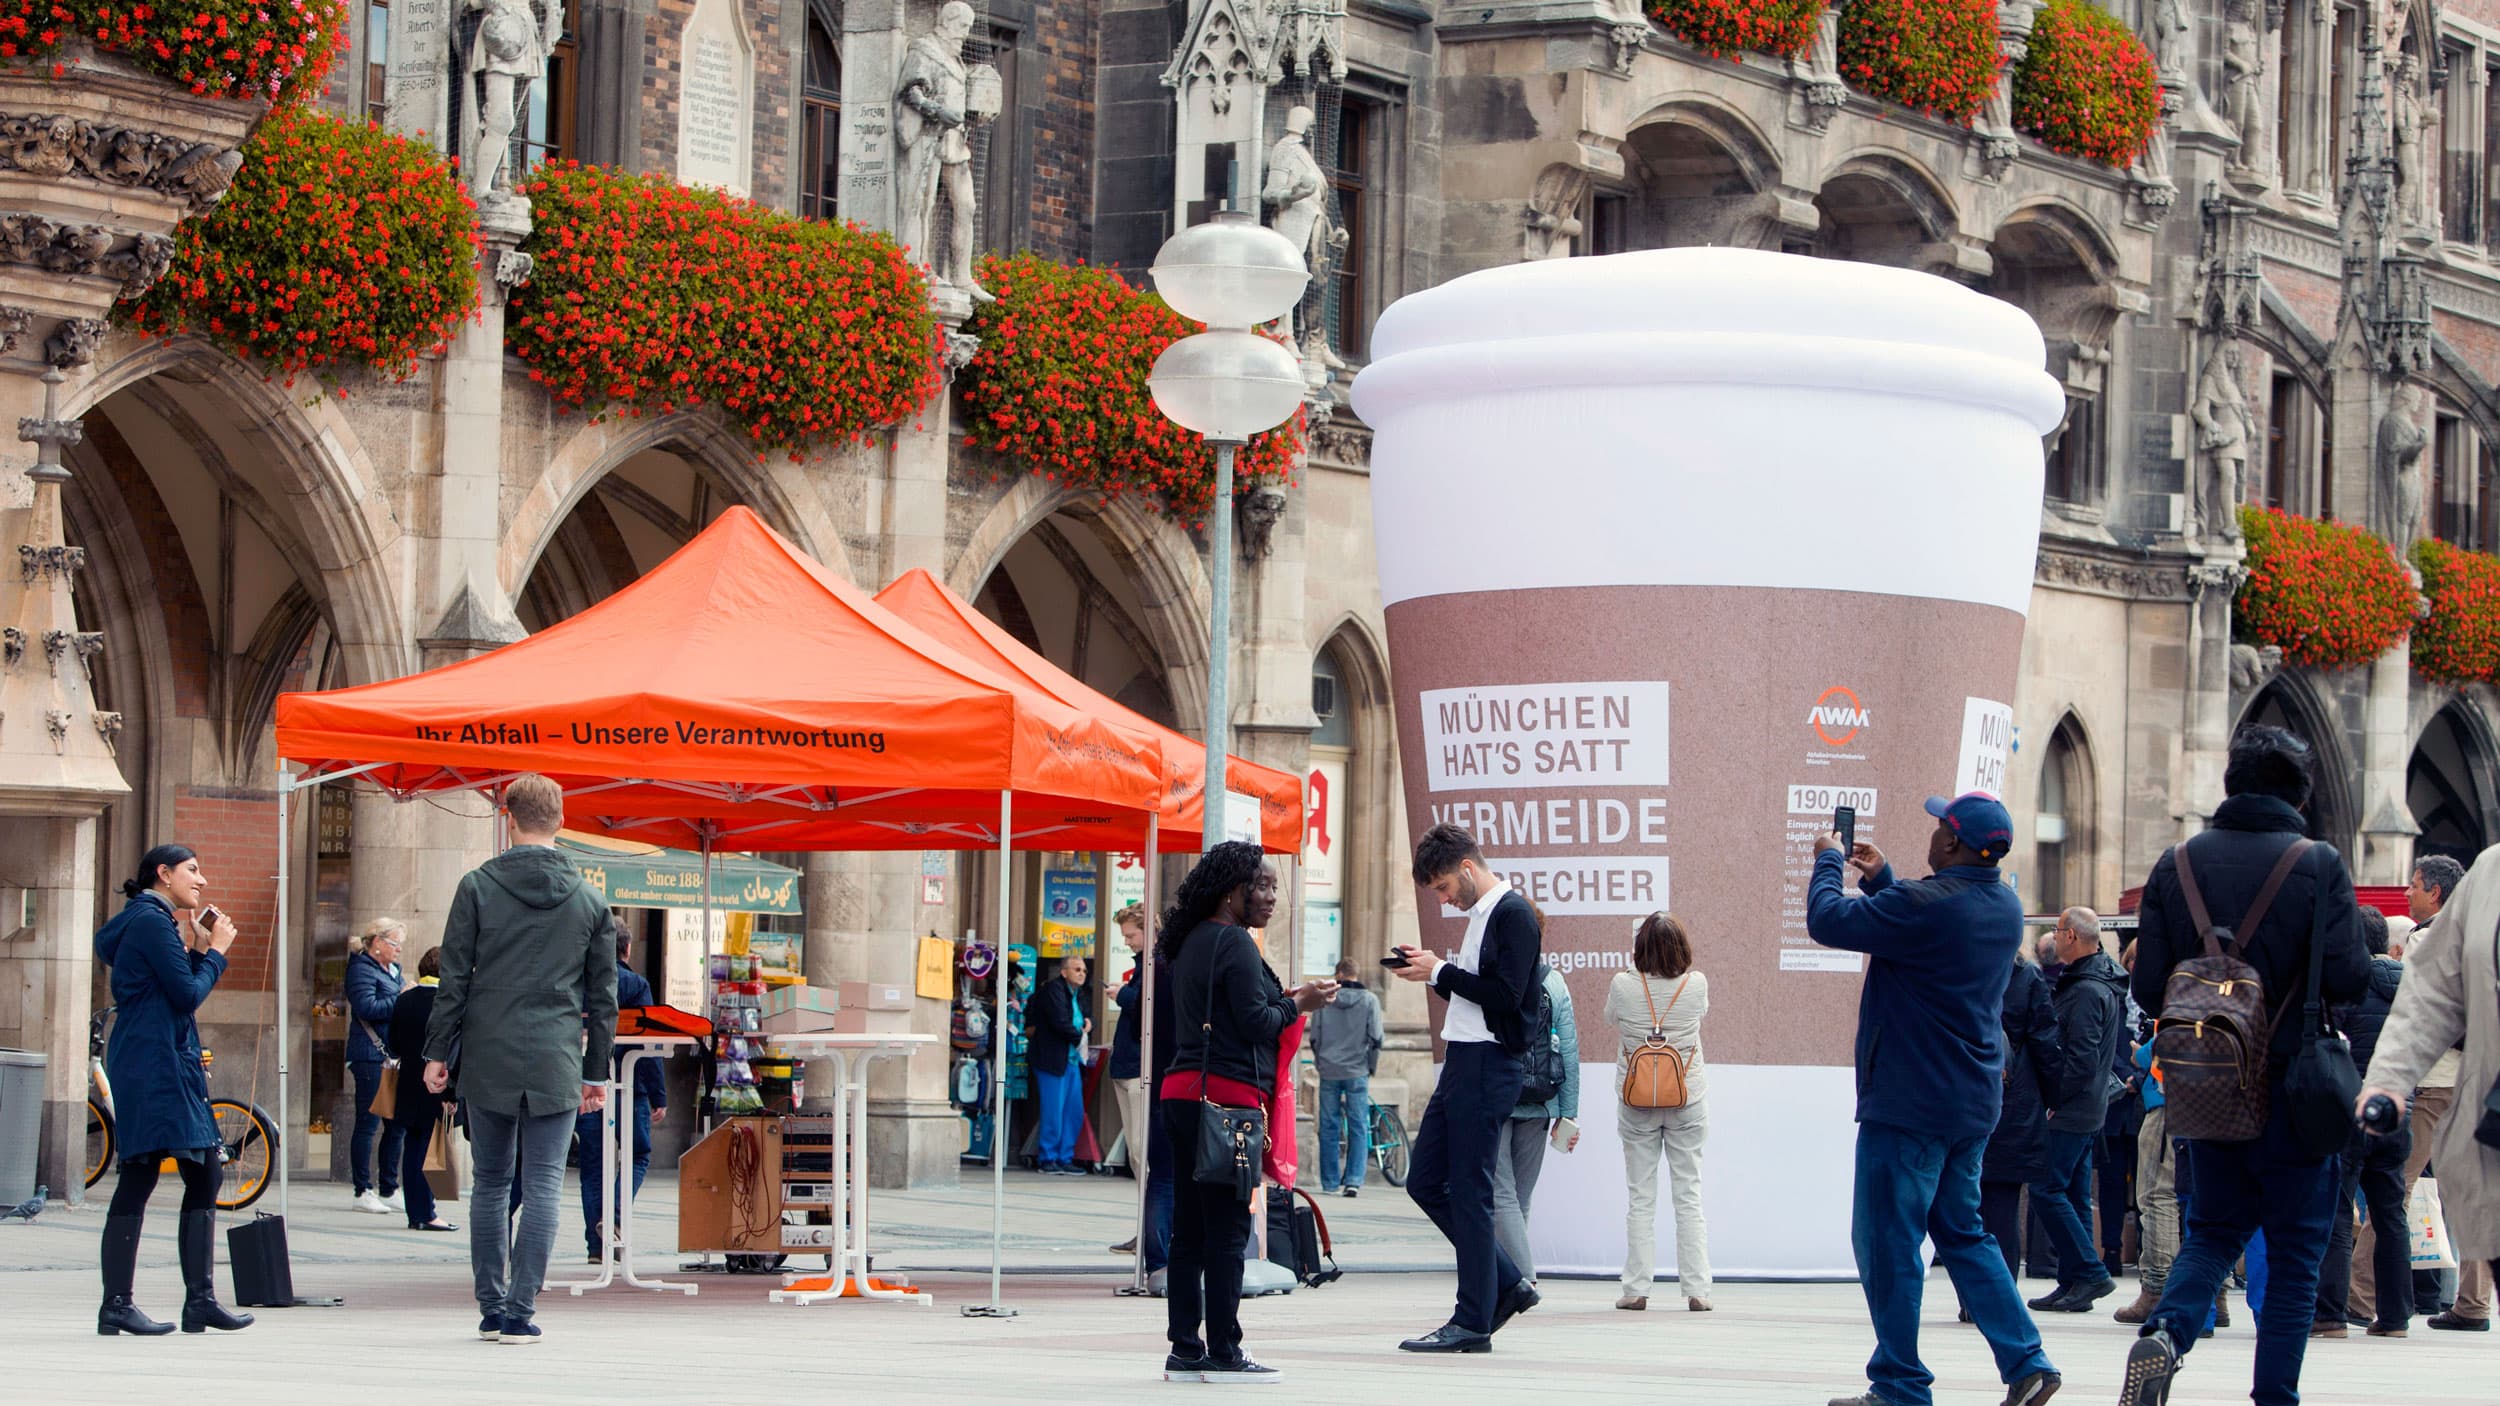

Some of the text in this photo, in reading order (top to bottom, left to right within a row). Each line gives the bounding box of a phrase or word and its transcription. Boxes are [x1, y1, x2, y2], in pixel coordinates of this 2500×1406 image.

[1439, 693, 1630, 735] MÜNCHEN
[1807, 706, 1870, 727] AWM
[416, 726, 452, 741] Ihr
[460, 722, 540, 744] Abfall
[571, 722, 669, 745] Unsere
[675, 720, 886, 753] Verantwortung
[1443, 739, 1630, 777] HAT'S SATT
[1793, 789, 1872, 811] 190.000
[1786, 832, 1814, 843] täglich
[1785, 856, 1798, 865] Ein
[646, 870, 677, 887] Since
[1493, 868, 1654, 903] BECHER
[615, 888, 639, 899] Oldest
[640, 889, 662, 900] amber
[664, 893, 696, 904] company
[719, 894, 739, 905] world
